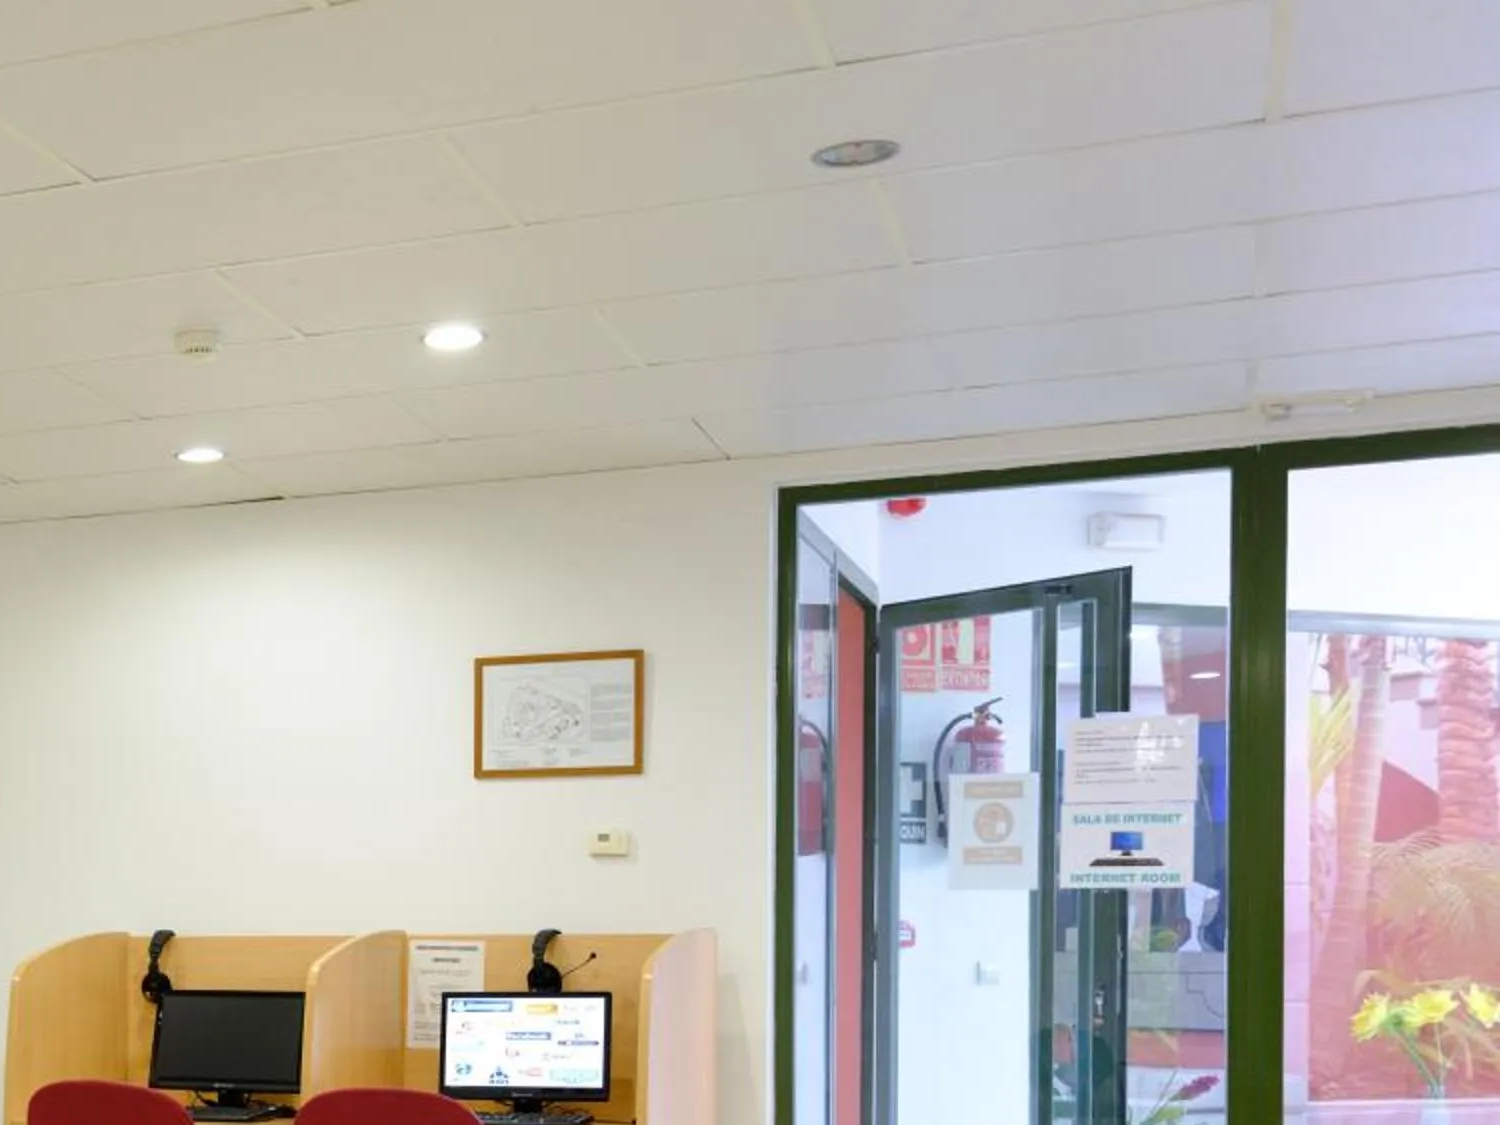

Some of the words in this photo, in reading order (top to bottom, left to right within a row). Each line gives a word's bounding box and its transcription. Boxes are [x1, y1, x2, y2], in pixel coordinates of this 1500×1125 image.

[1073, 814, 1101, 825] SALA
[1124, 813, 1183, 825] INTERNET
[1070, 873, 1137, 884] INTERNET
[1141, 872, 1181, 884] ROOM
